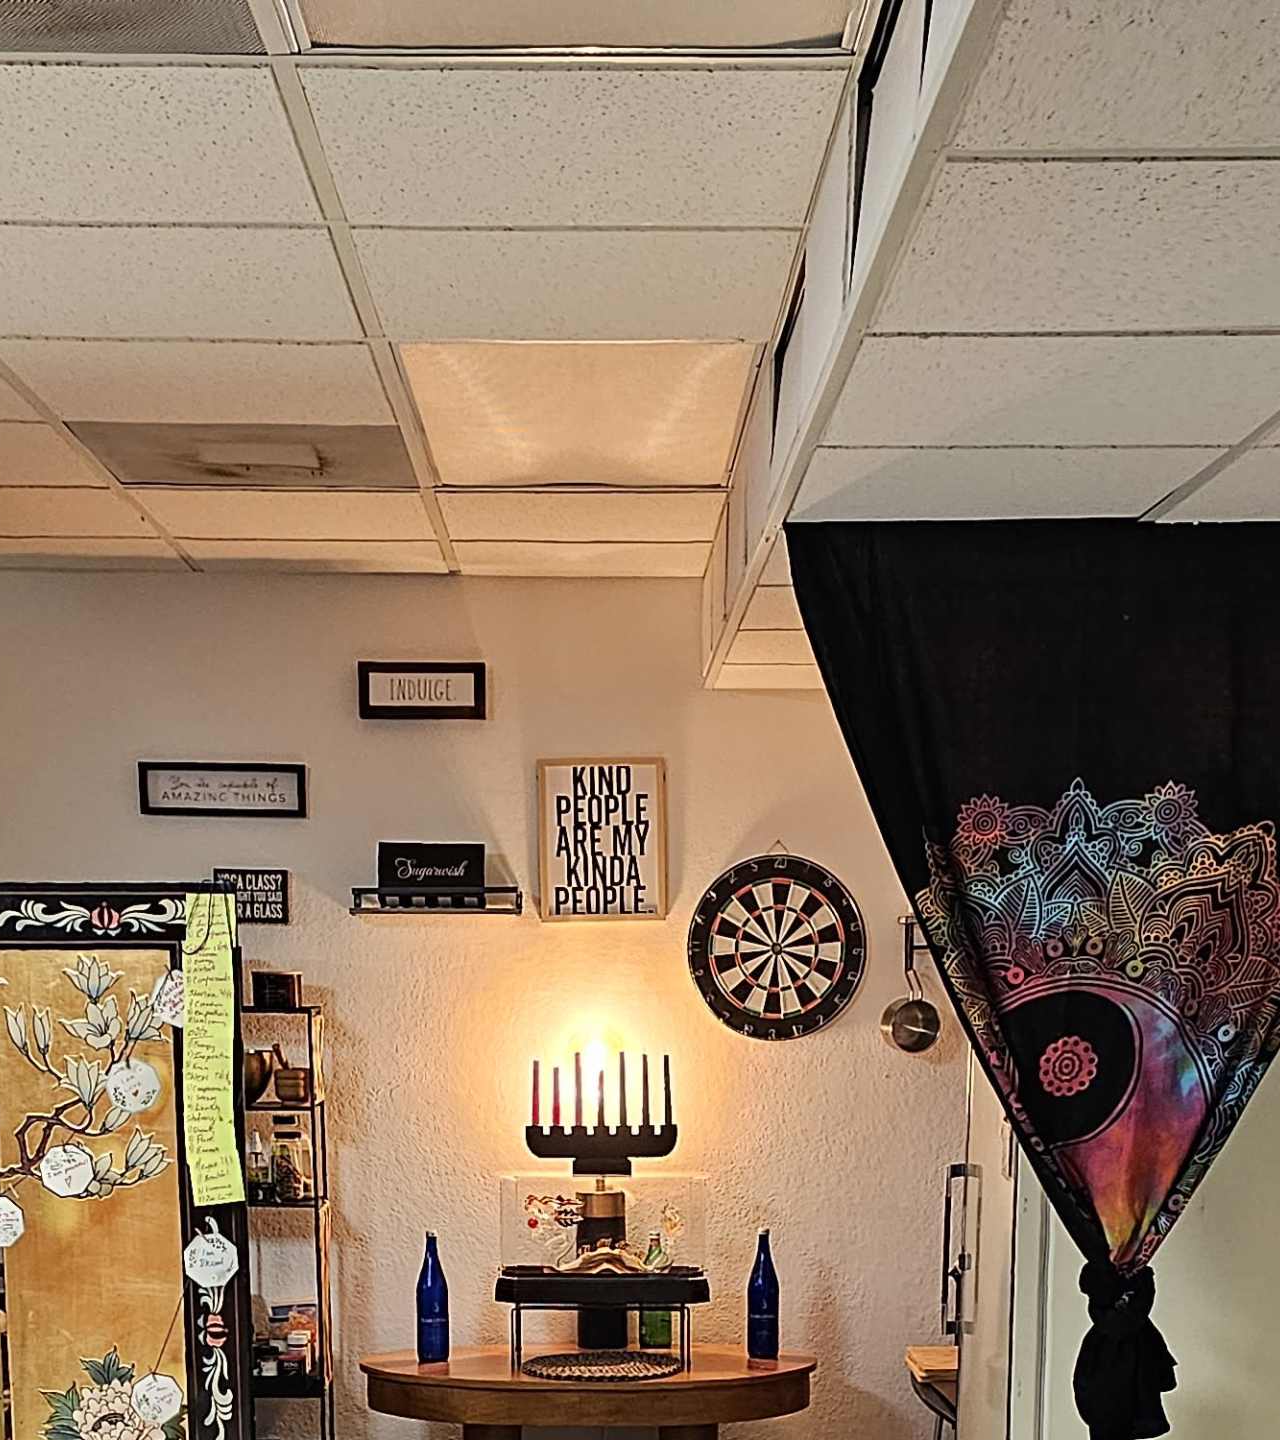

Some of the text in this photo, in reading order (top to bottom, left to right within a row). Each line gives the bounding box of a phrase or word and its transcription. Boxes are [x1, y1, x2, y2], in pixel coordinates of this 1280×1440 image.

[389, 678, 457, 702] INDULGE.
[572, 766, 631, 796] KIND
[233, 792, 286, 804] THINGS
[556, 794, 649, 827] PEOPLE
[556, 821, 650, 857] ARE MY
[246, 873, 283, 891] CLASS?
[394, 857, 469, 881] Sugarwish
[566, 854, 642, 888] KINDA
[245, 903, 252, 919] A
[253, 903, 283, 919] GLASS
[554, 885, 655, 915] PEOPLE.
